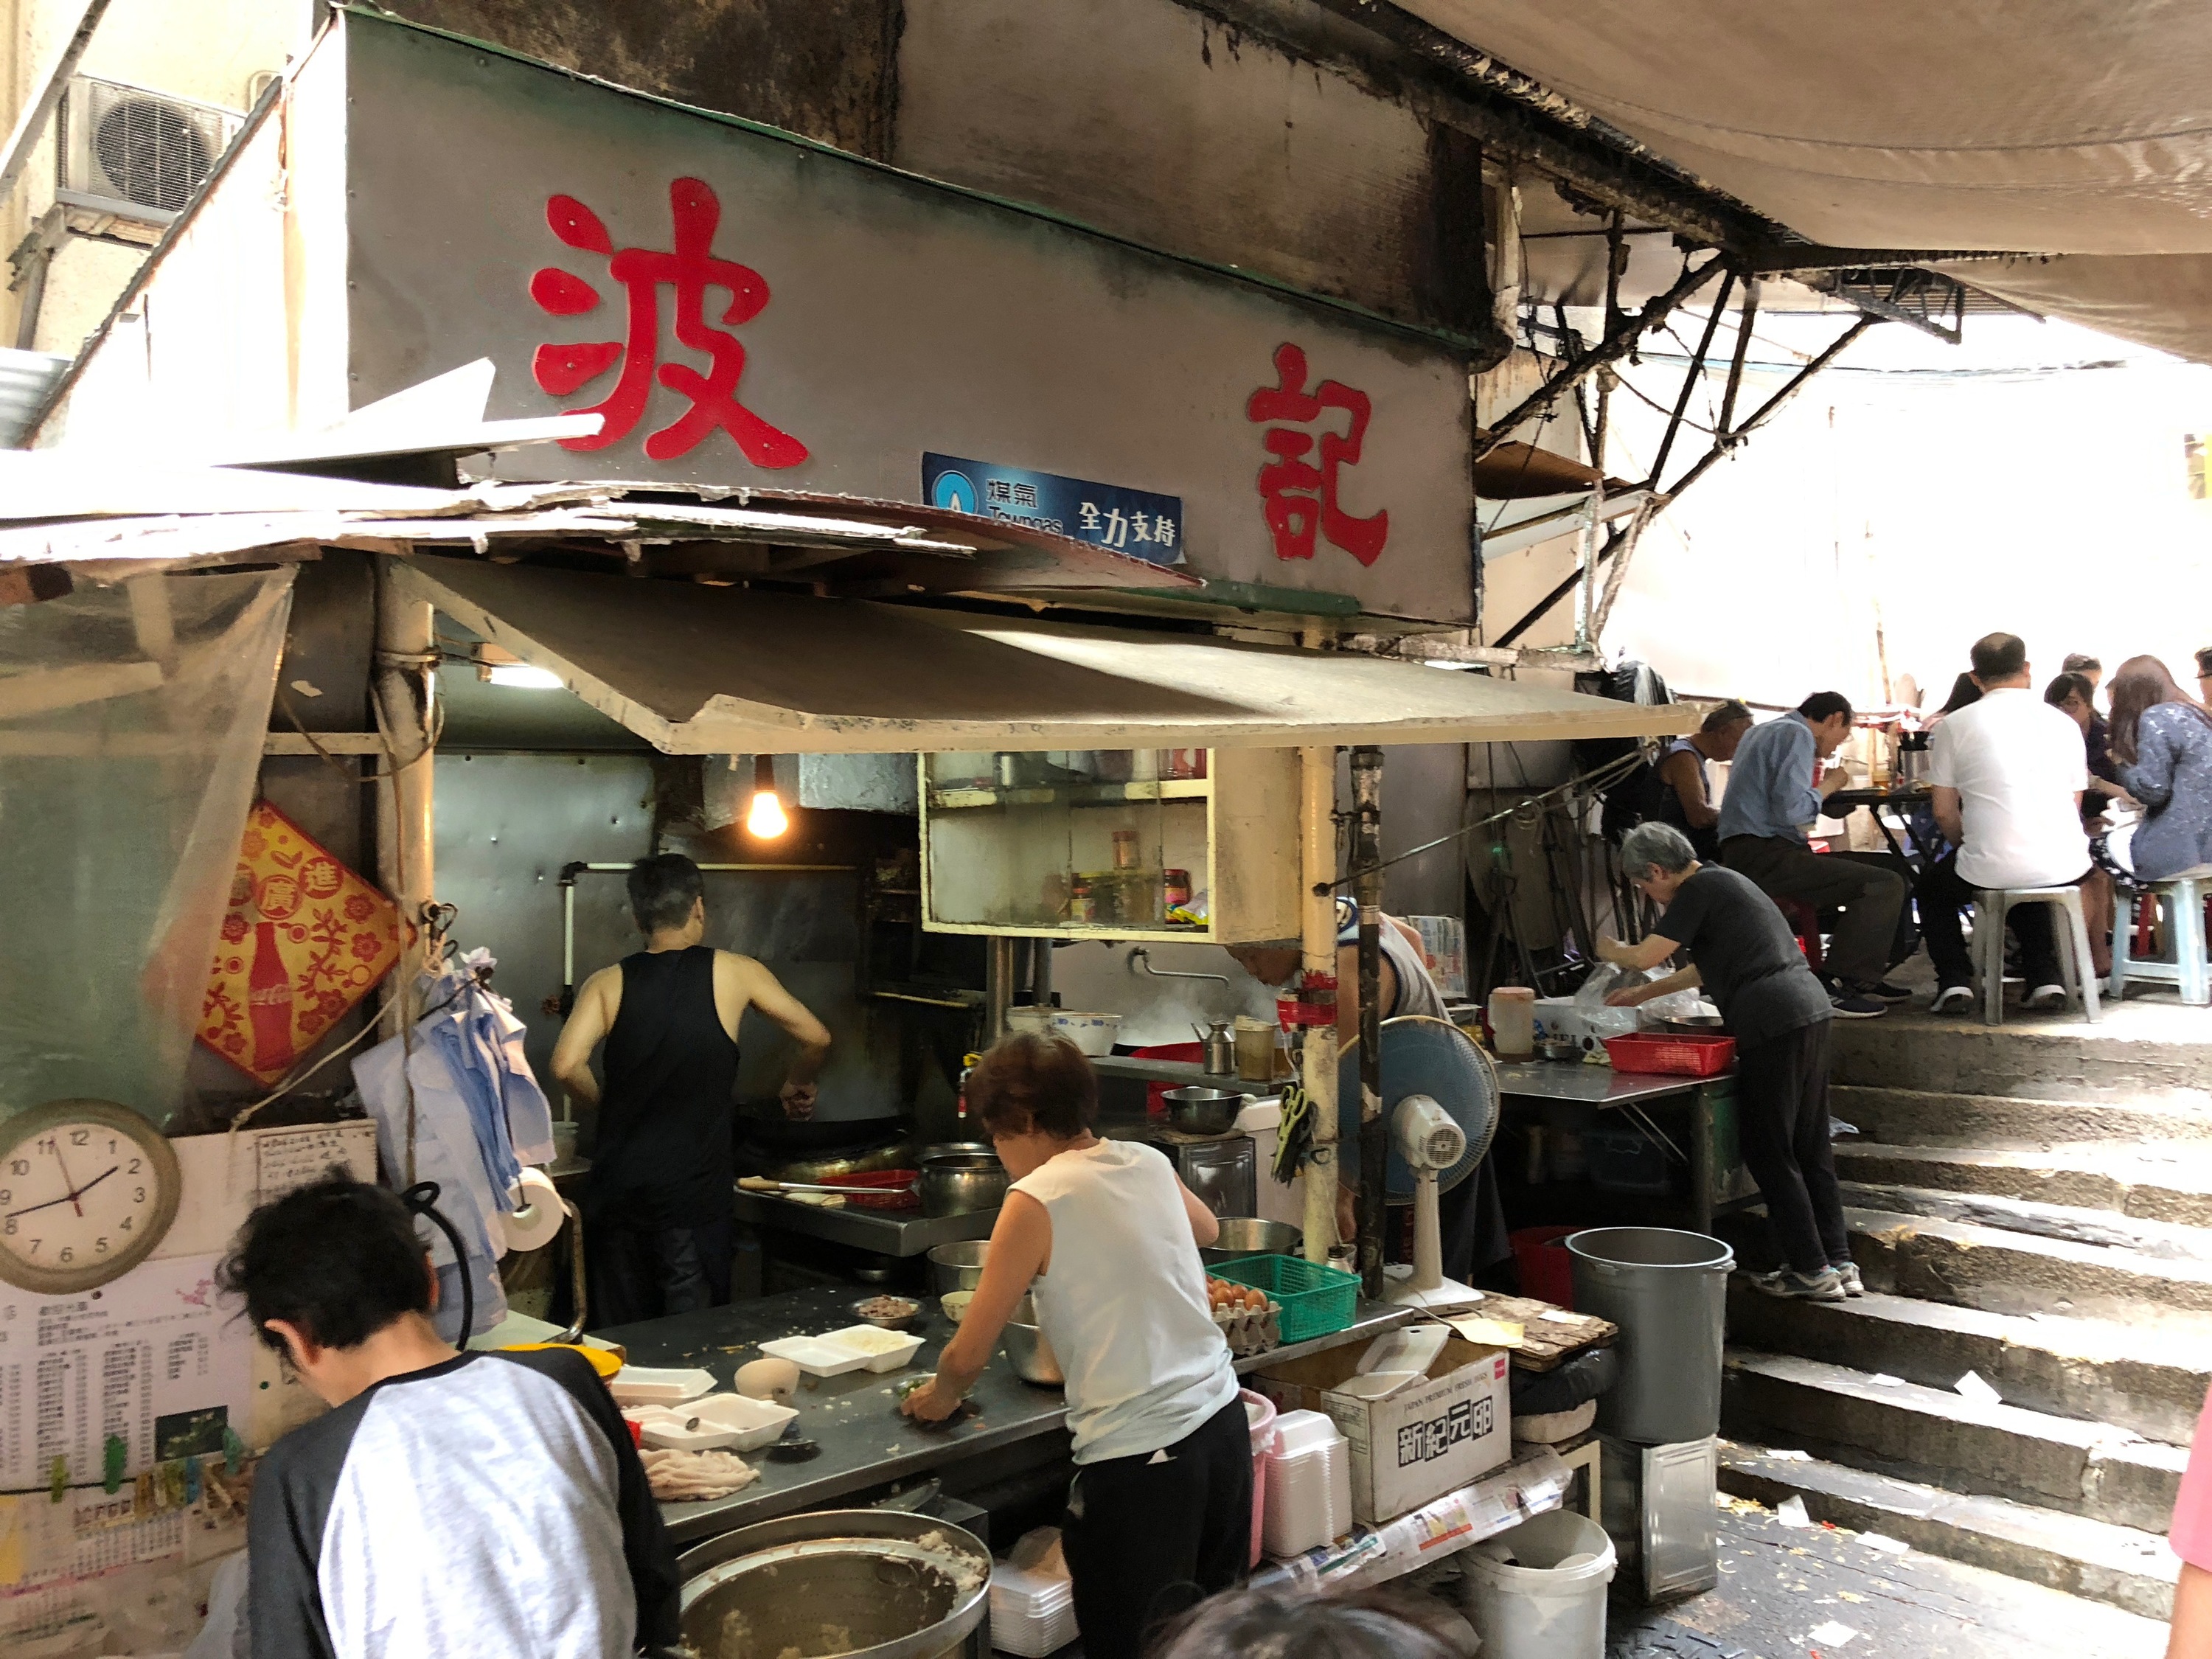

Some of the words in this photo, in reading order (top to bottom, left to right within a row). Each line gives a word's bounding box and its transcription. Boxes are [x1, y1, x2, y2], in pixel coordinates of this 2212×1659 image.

[529, 176, 810, 469] 波
[1248, 341, 1389, 567] 記
[987, 479, 1038, 509] 煤氣
[1079, 502, 1175, 547] 全力支持
[69, 1129, 90, 1146] 12
[108, 1138, 116, 1154] 1
[38, 1138, 56, 1155] 11
[10, 1159, 30, 1176] 10
[128, 1158, 142, 1174] 2
[0, 1189, 12, 1205] 9
[133, 1186, 146, 1203] 3
[5, 1218, 18, 1235] 8
[119, 1216, 132, 1231] 4
[29, 1239, 42, 1253] 7
[95, 1237, 108, 1253] 5
[60, 1246, 73, 1262] 6
